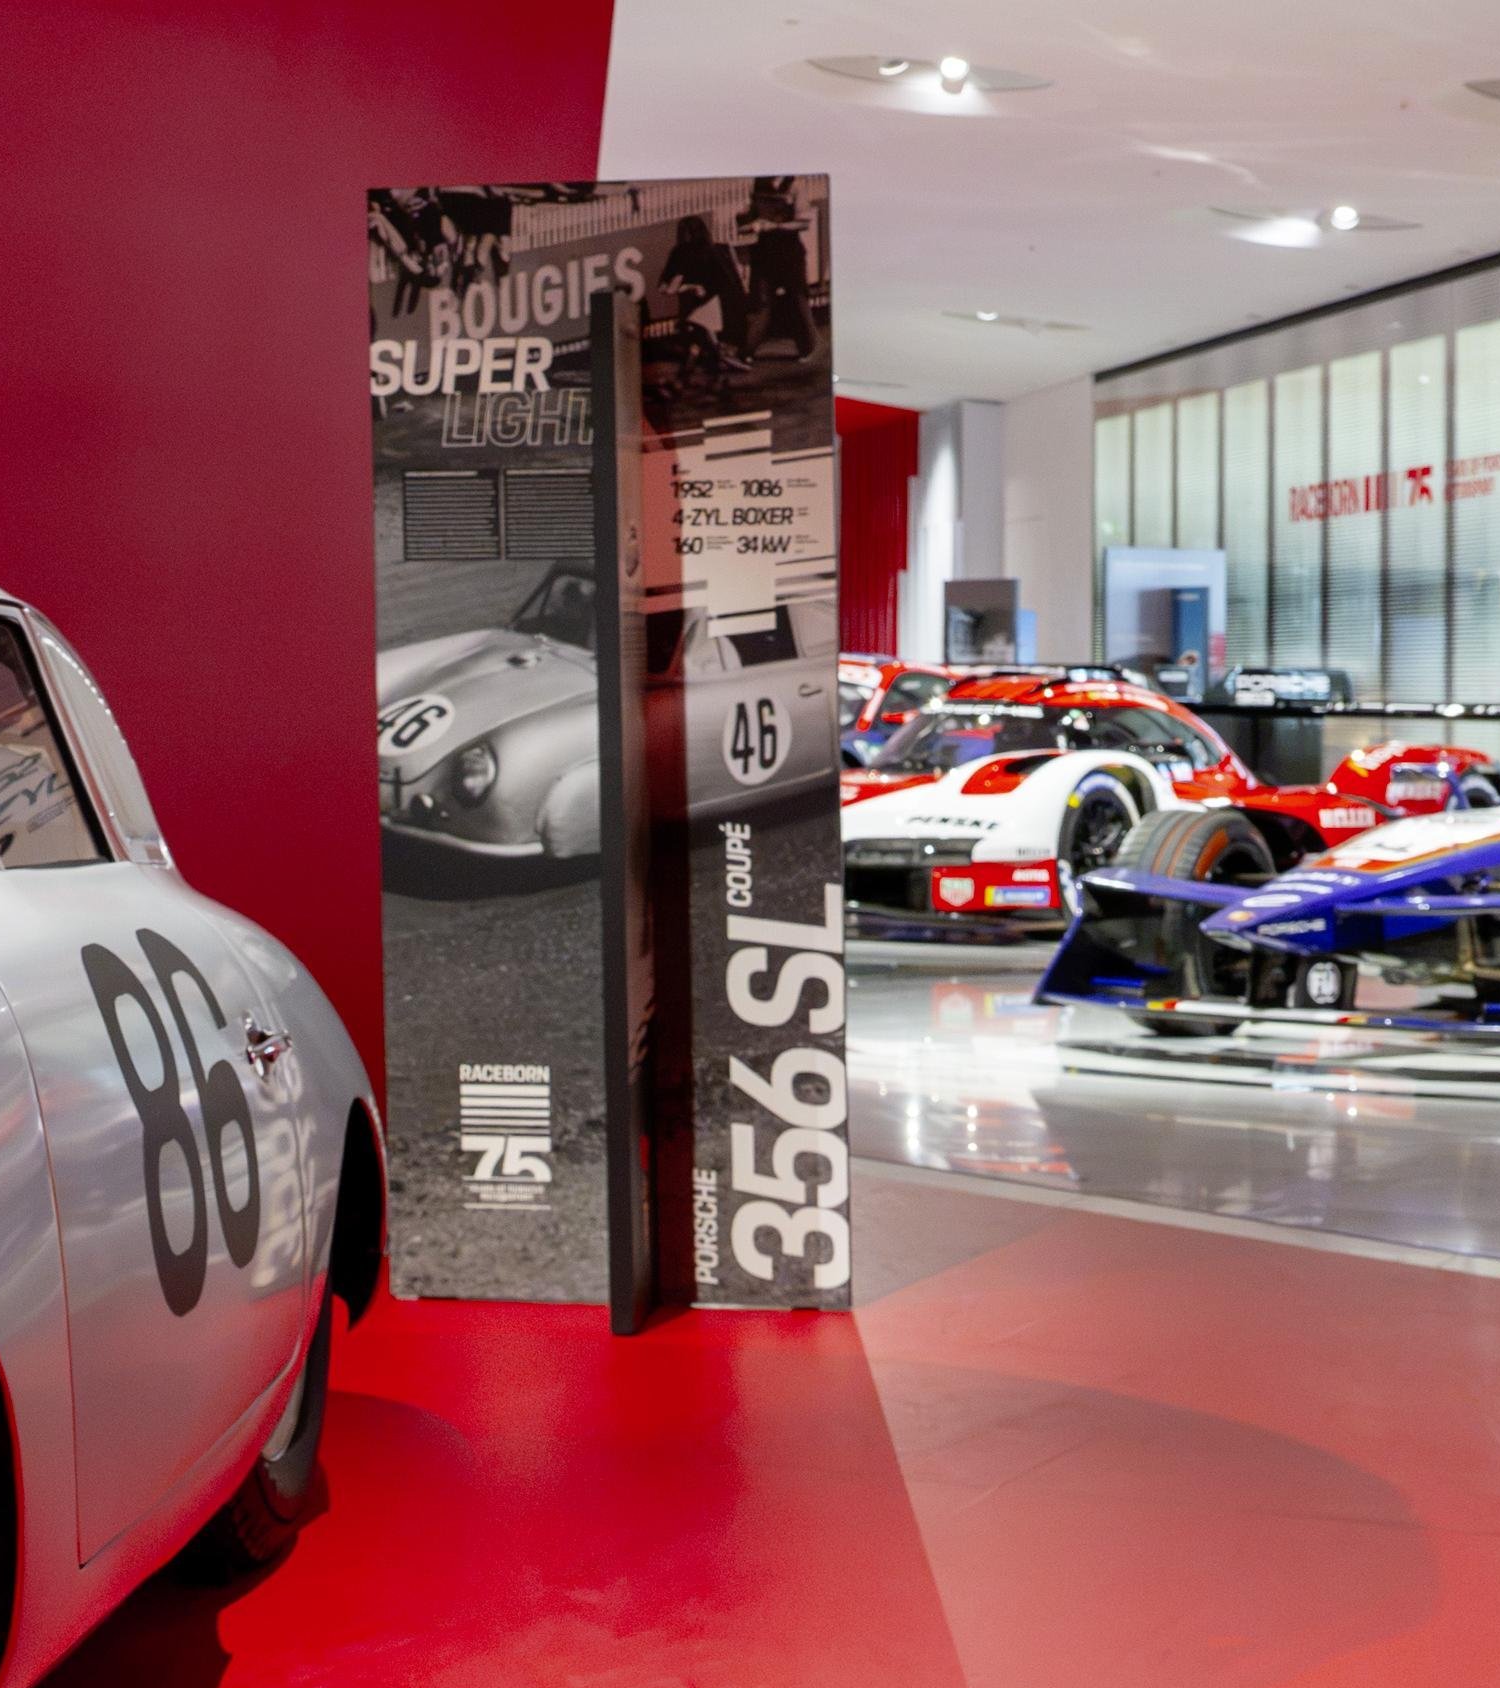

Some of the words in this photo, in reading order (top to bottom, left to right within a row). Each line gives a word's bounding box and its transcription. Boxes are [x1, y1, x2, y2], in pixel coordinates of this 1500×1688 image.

[369, 336, 554, 396] SUPER
[442, 388, 594, 447] LIGHT
[670, 479, 714, 498] 1952
[741, 479, 783, 498] 1086
[733, 507, 794, 526] BOXER
[672, 537, 703, 555] 160
[737, 536, 758, 554] 34
[377, 699, 447, 749] 46
[732, 697, 776, 774] 46
[719, 822, 753, 907] COUPÉ
[726, 883, 846, 1034] SL
[459, 1063, 550, 1083] RACEBORN
[81, 928, 261, 1317] 86
[460, 1134, 552, 1183] 75
[730, 1047, 851, 1289] 356
[695, 1168, 718, 1285] PORSCHE
